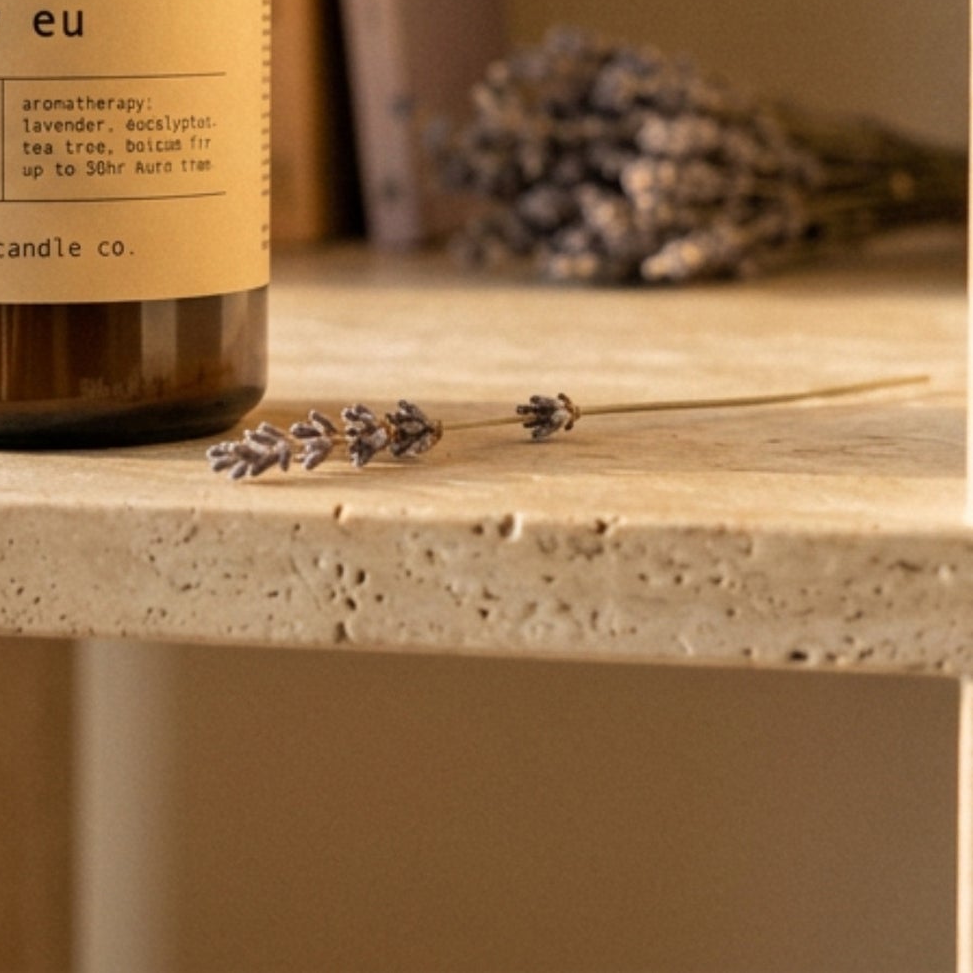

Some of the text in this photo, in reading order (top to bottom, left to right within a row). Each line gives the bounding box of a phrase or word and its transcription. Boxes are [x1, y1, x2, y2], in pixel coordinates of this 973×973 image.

[33, 9, 85, 37] eu
[22, 96, 152, 114] aromatherapy:
[22, 140, 54, 155] tea
[22, 164, 44, 180] up
[55, 162, 77, 177] to
[97, 238, 136, 258] co.
